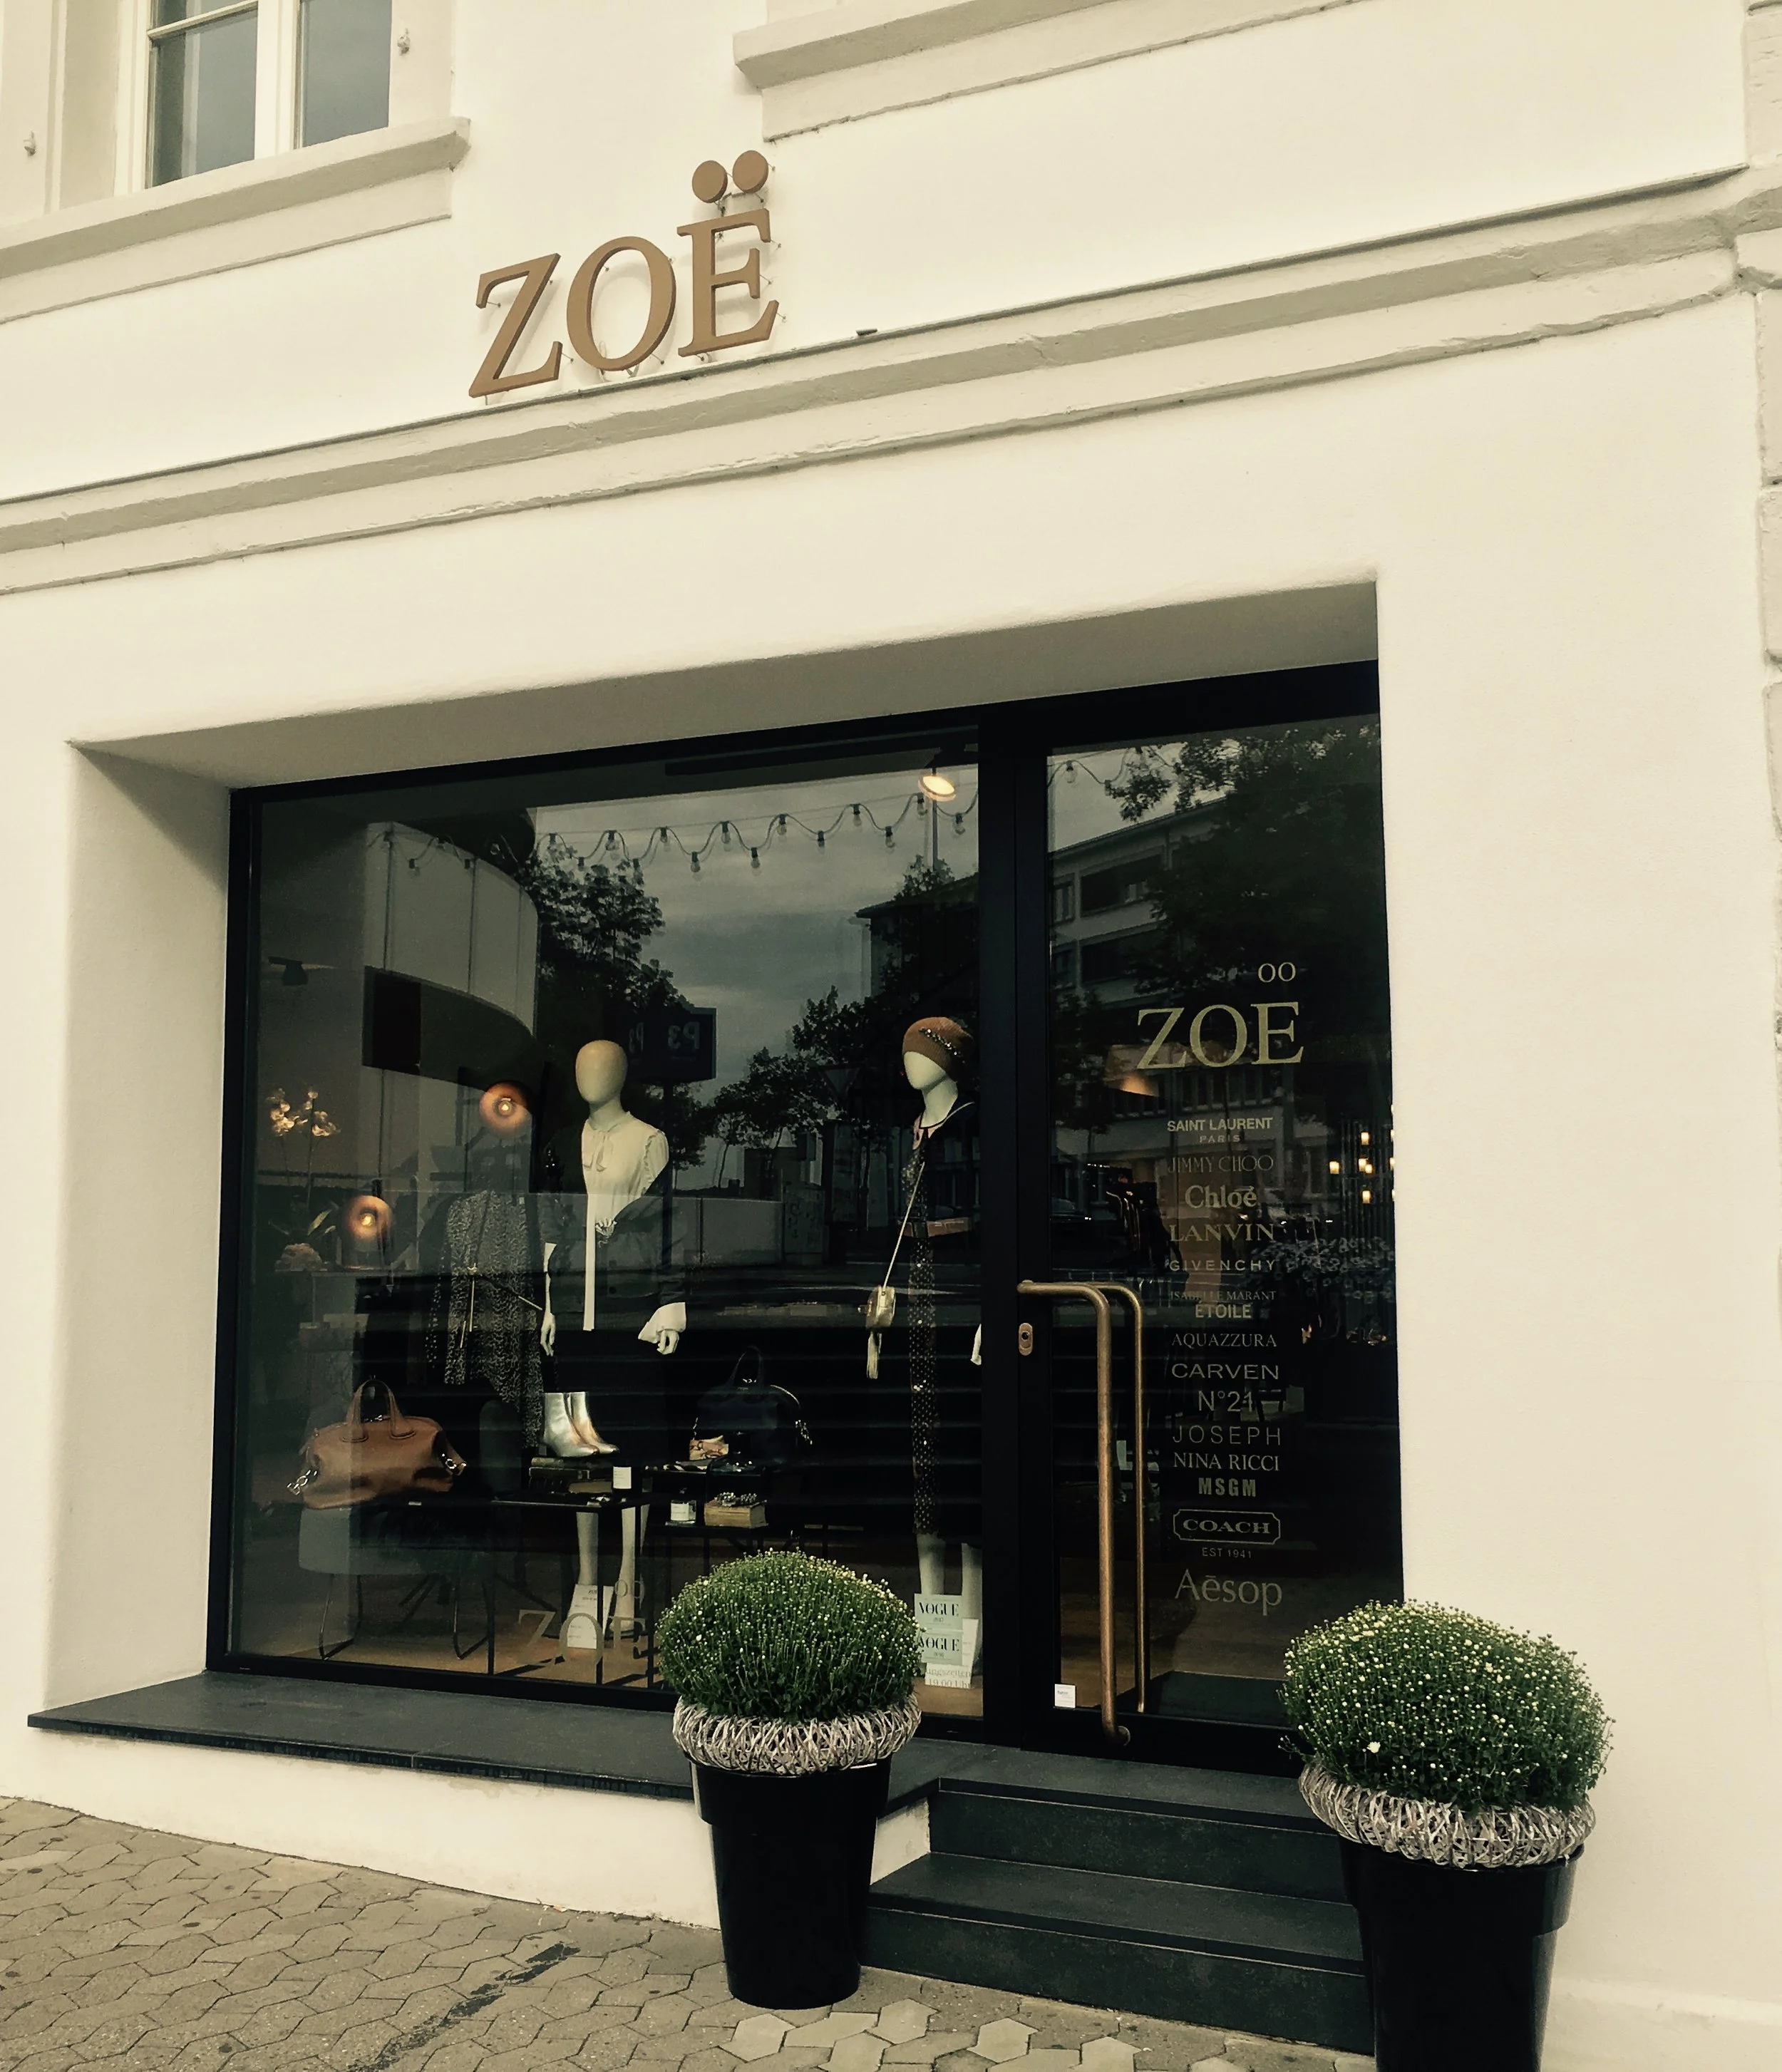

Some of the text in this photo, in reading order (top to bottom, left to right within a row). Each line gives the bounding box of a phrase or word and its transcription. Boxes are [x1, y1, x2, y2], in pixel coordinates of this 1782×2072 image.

[468, 150, 780, 398] ZOË
[1167, 1118, 1272, 1132] SAINT LAURENT
[1199, 1135, 1241, 1144] PARIS
[1168, 1155, 1274, 1174] JIMMY CHOO
[1169, 1224, 1274, 1242] LANVIN
[1169, 1260, 1277, 1272] GIVENCHY
[1227, 1291, 1277, 1300] MARANT
[1171, 1334, 1277, 1349] AQUAZZURA
[1171, 1364, 1279, 1380] CARVEN
[1173, 1426, 1281, 1445] JOSEPH
[1173, 1453, 1279, 1471] NINA RICCI
[1198, 1478, 1256, 1497] MSGM
[1183, 1519, 1270, 1535] COACH
[1202, 1547, 1252, 1559] EST 1941
[919, 1602, 959, 1617] VOGUE
